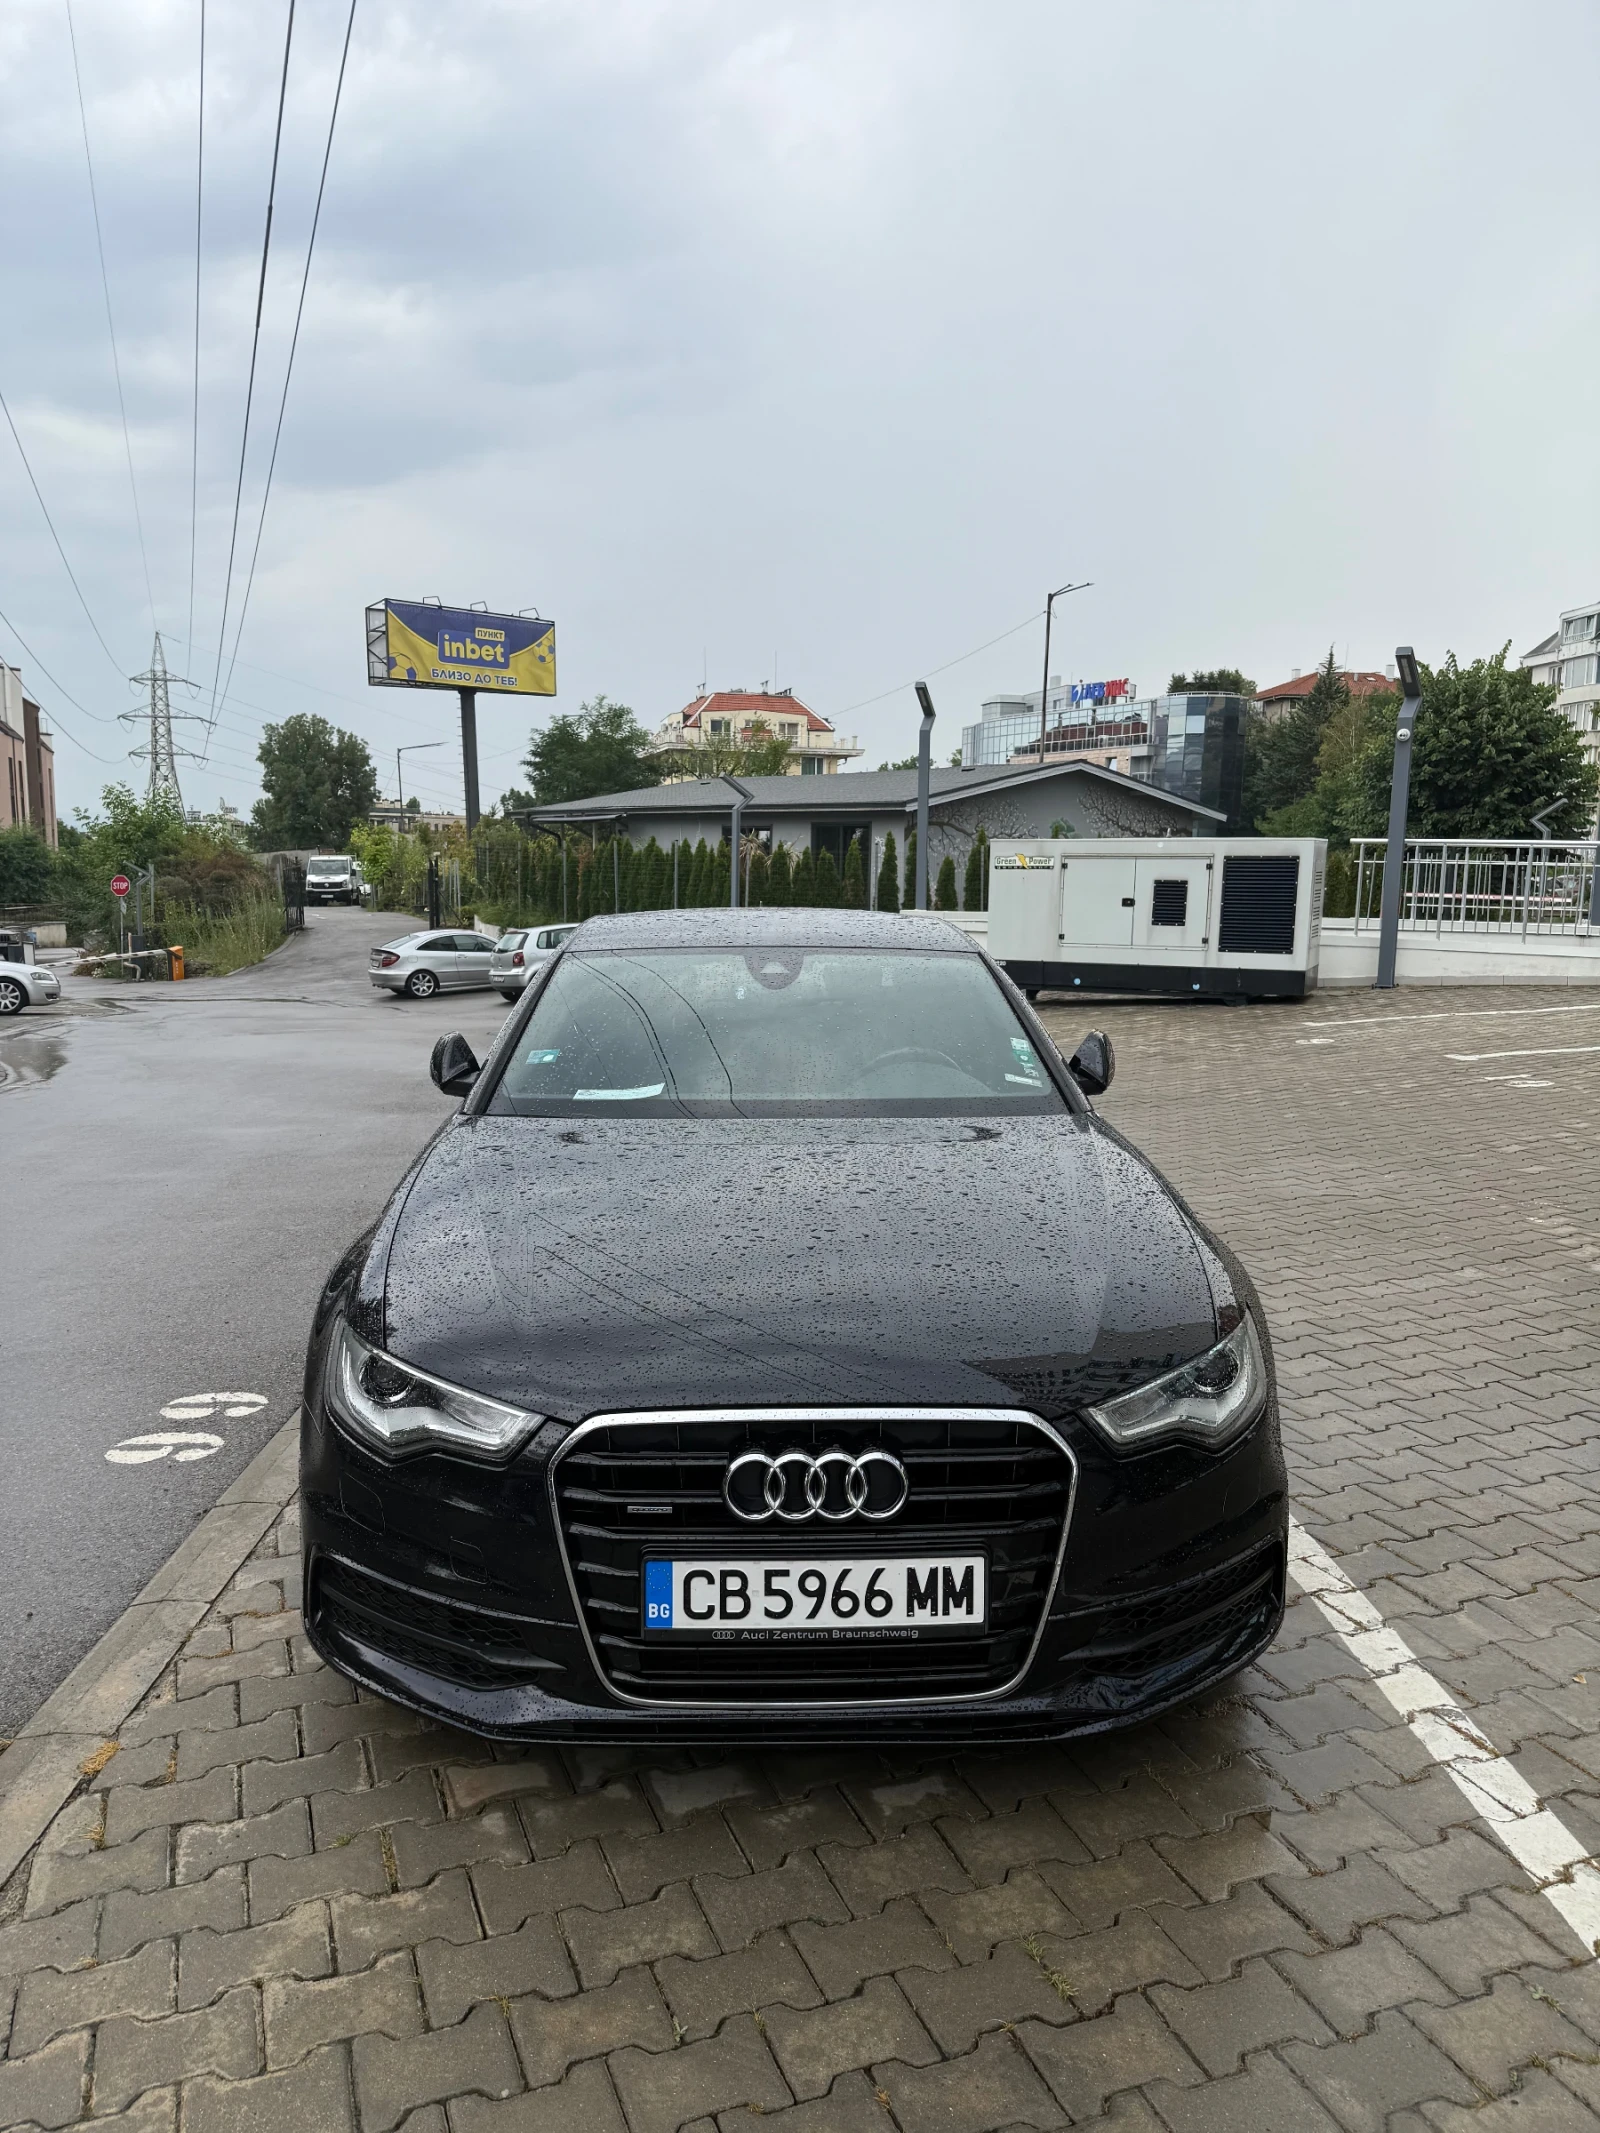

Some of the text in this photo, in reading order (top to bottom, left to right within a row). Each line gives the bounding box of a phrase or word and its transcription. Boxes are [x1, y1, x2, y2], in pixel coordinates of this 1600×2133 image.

[477, 629, 504, 640] ПУНКТ
[443, 633, 505, 663] inbet
[431, 668, 518, 686] БЛИЗО ДО ТЕБ!
[996, 857, 1052, 865] Green Power
[112, 881, 128, 890] STOP
[648, 1602, 670, 1619] BG
[772, 1630, 829, 1640] Zentrum
[832, 1628, 919, 1640] Braunschweig
